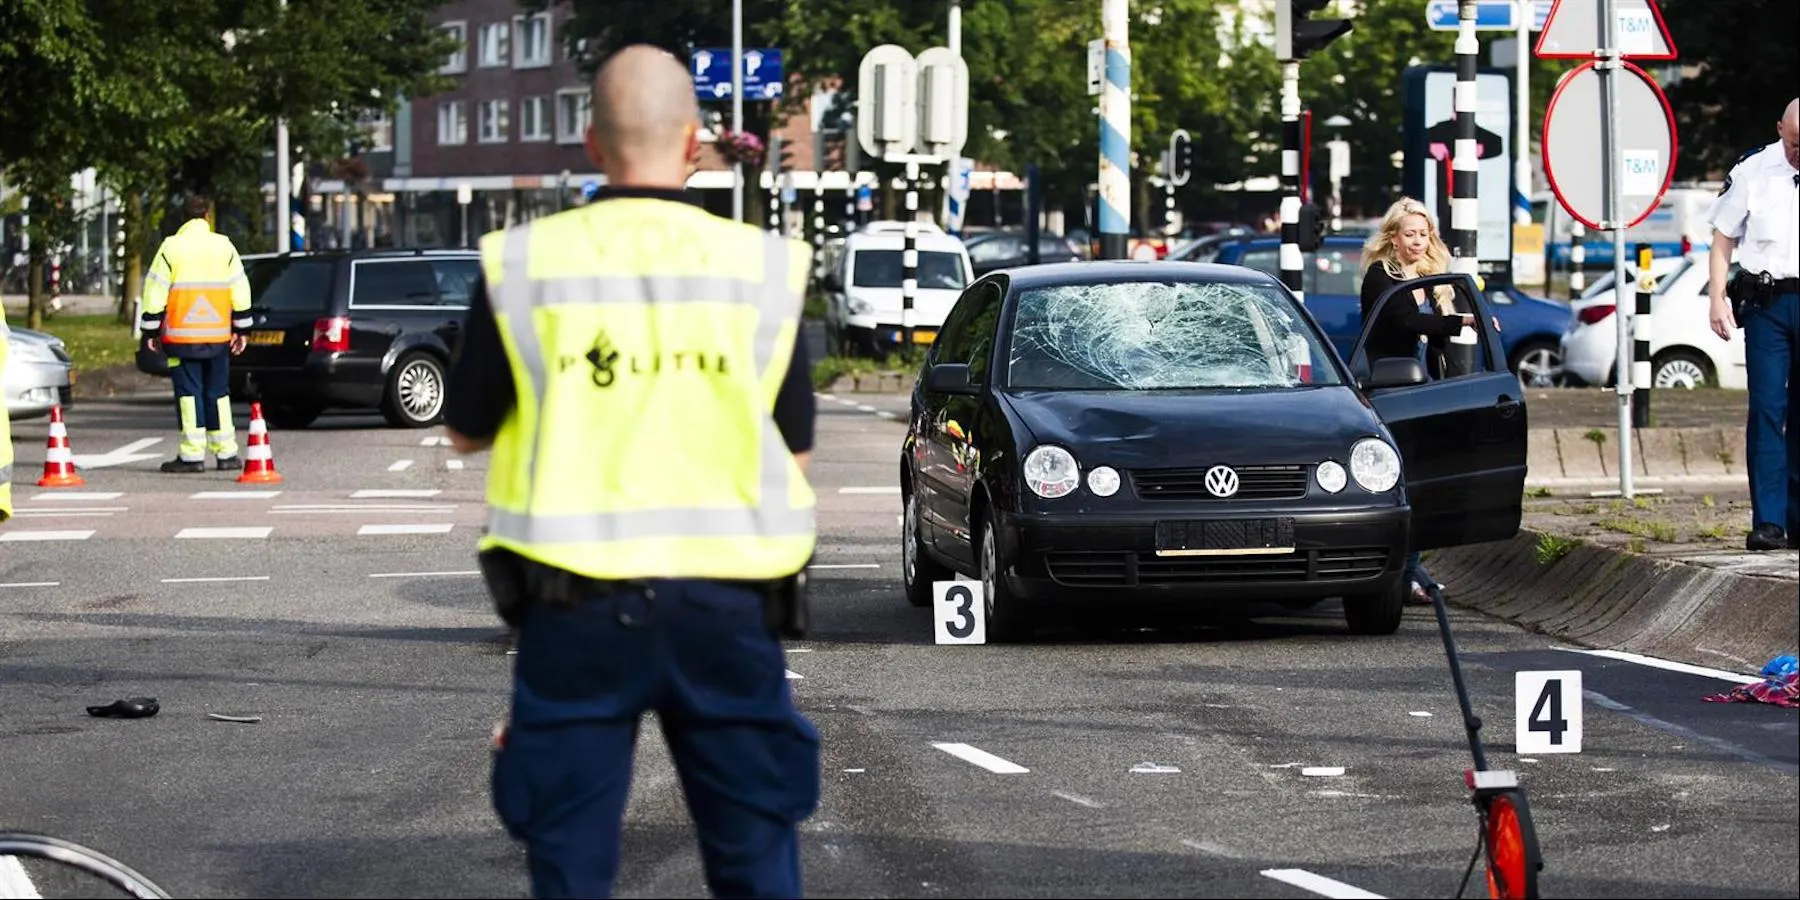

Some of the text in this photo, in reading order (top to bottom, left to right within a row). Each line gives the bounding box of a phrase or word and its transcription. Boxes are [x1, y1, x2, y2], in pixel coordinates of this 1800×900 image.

[1618, 17, 1650, 33] T&M
[1625, 158, 1657, 174] T&M
[945, 585, 976, 639] 3
[1528, 679, 1568, 745] 4
